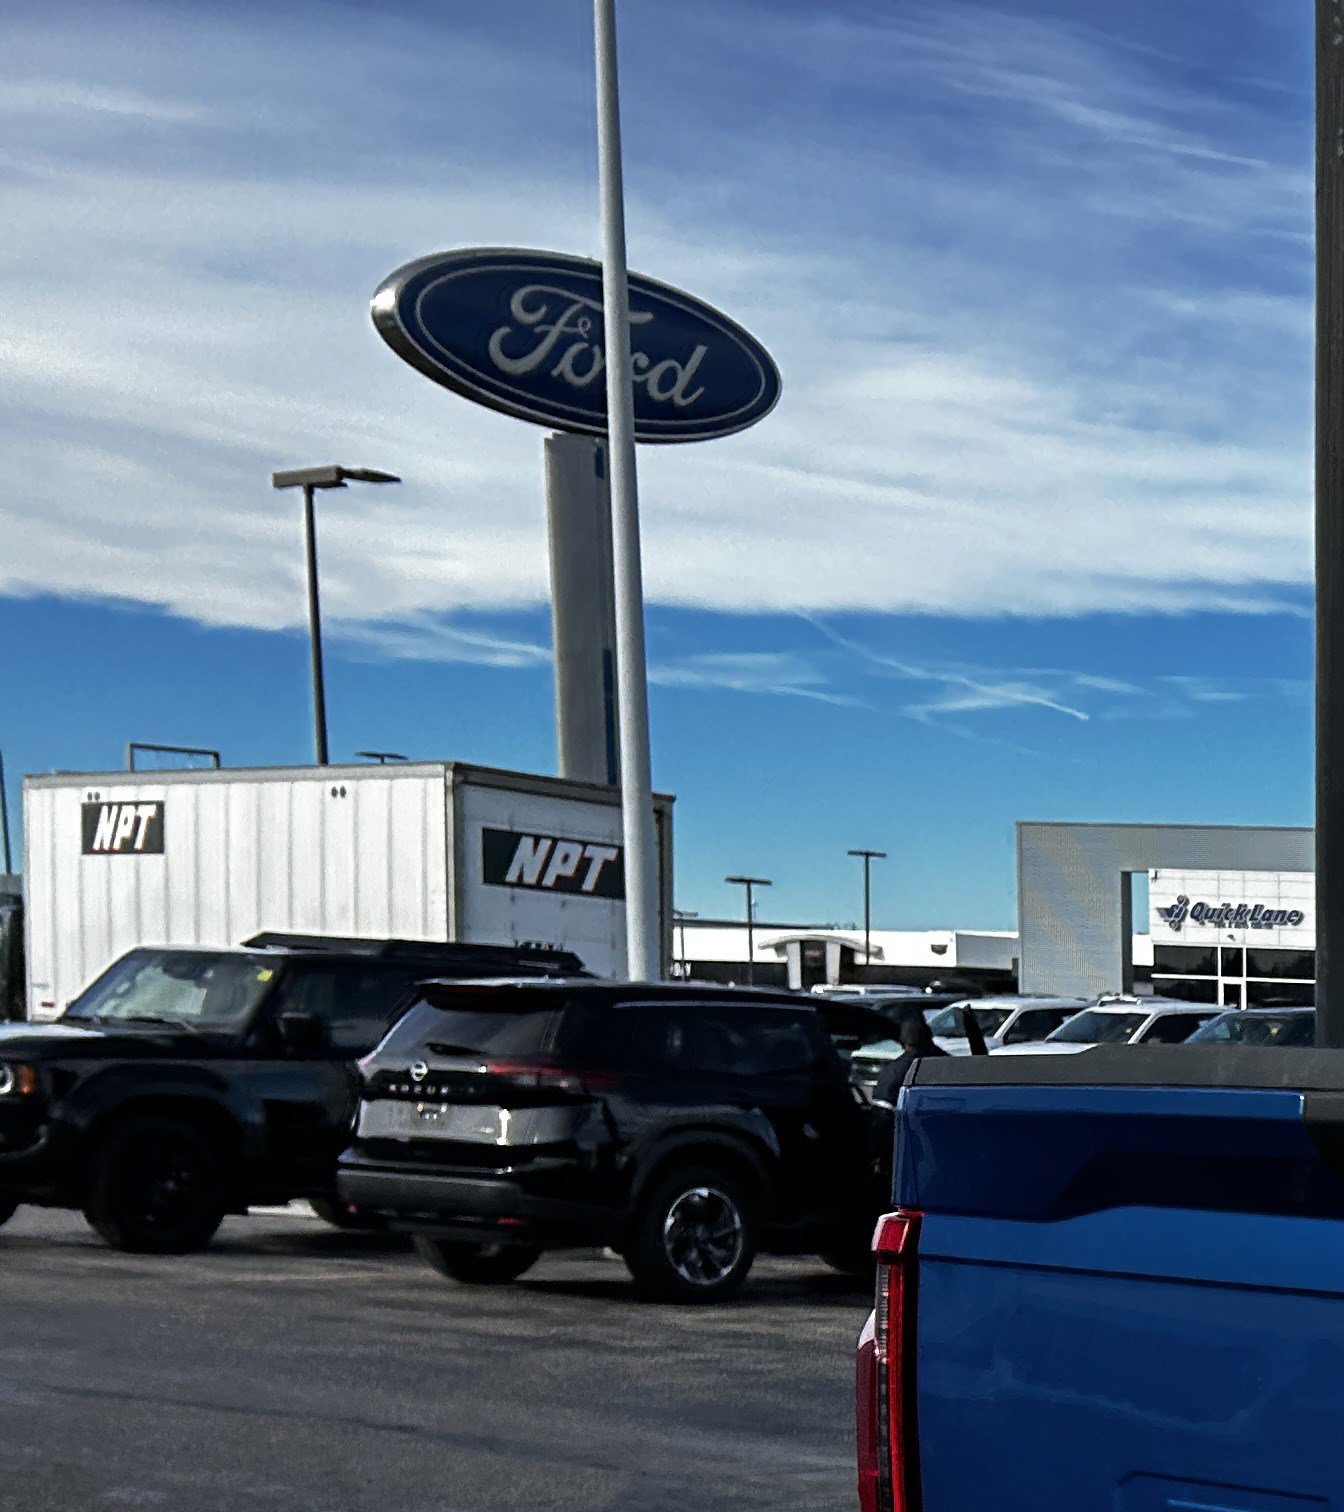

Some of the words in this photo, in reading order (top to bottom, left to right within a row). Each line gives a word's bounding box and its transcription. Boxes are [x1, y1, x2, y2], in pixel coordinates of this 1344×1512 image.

[92, 804, 157, 851] NPT
[505, 836, 619, 892] NPT
[1190, 902, 1249, 924] Quick
[1249, 904, 1305, 926] Lane
